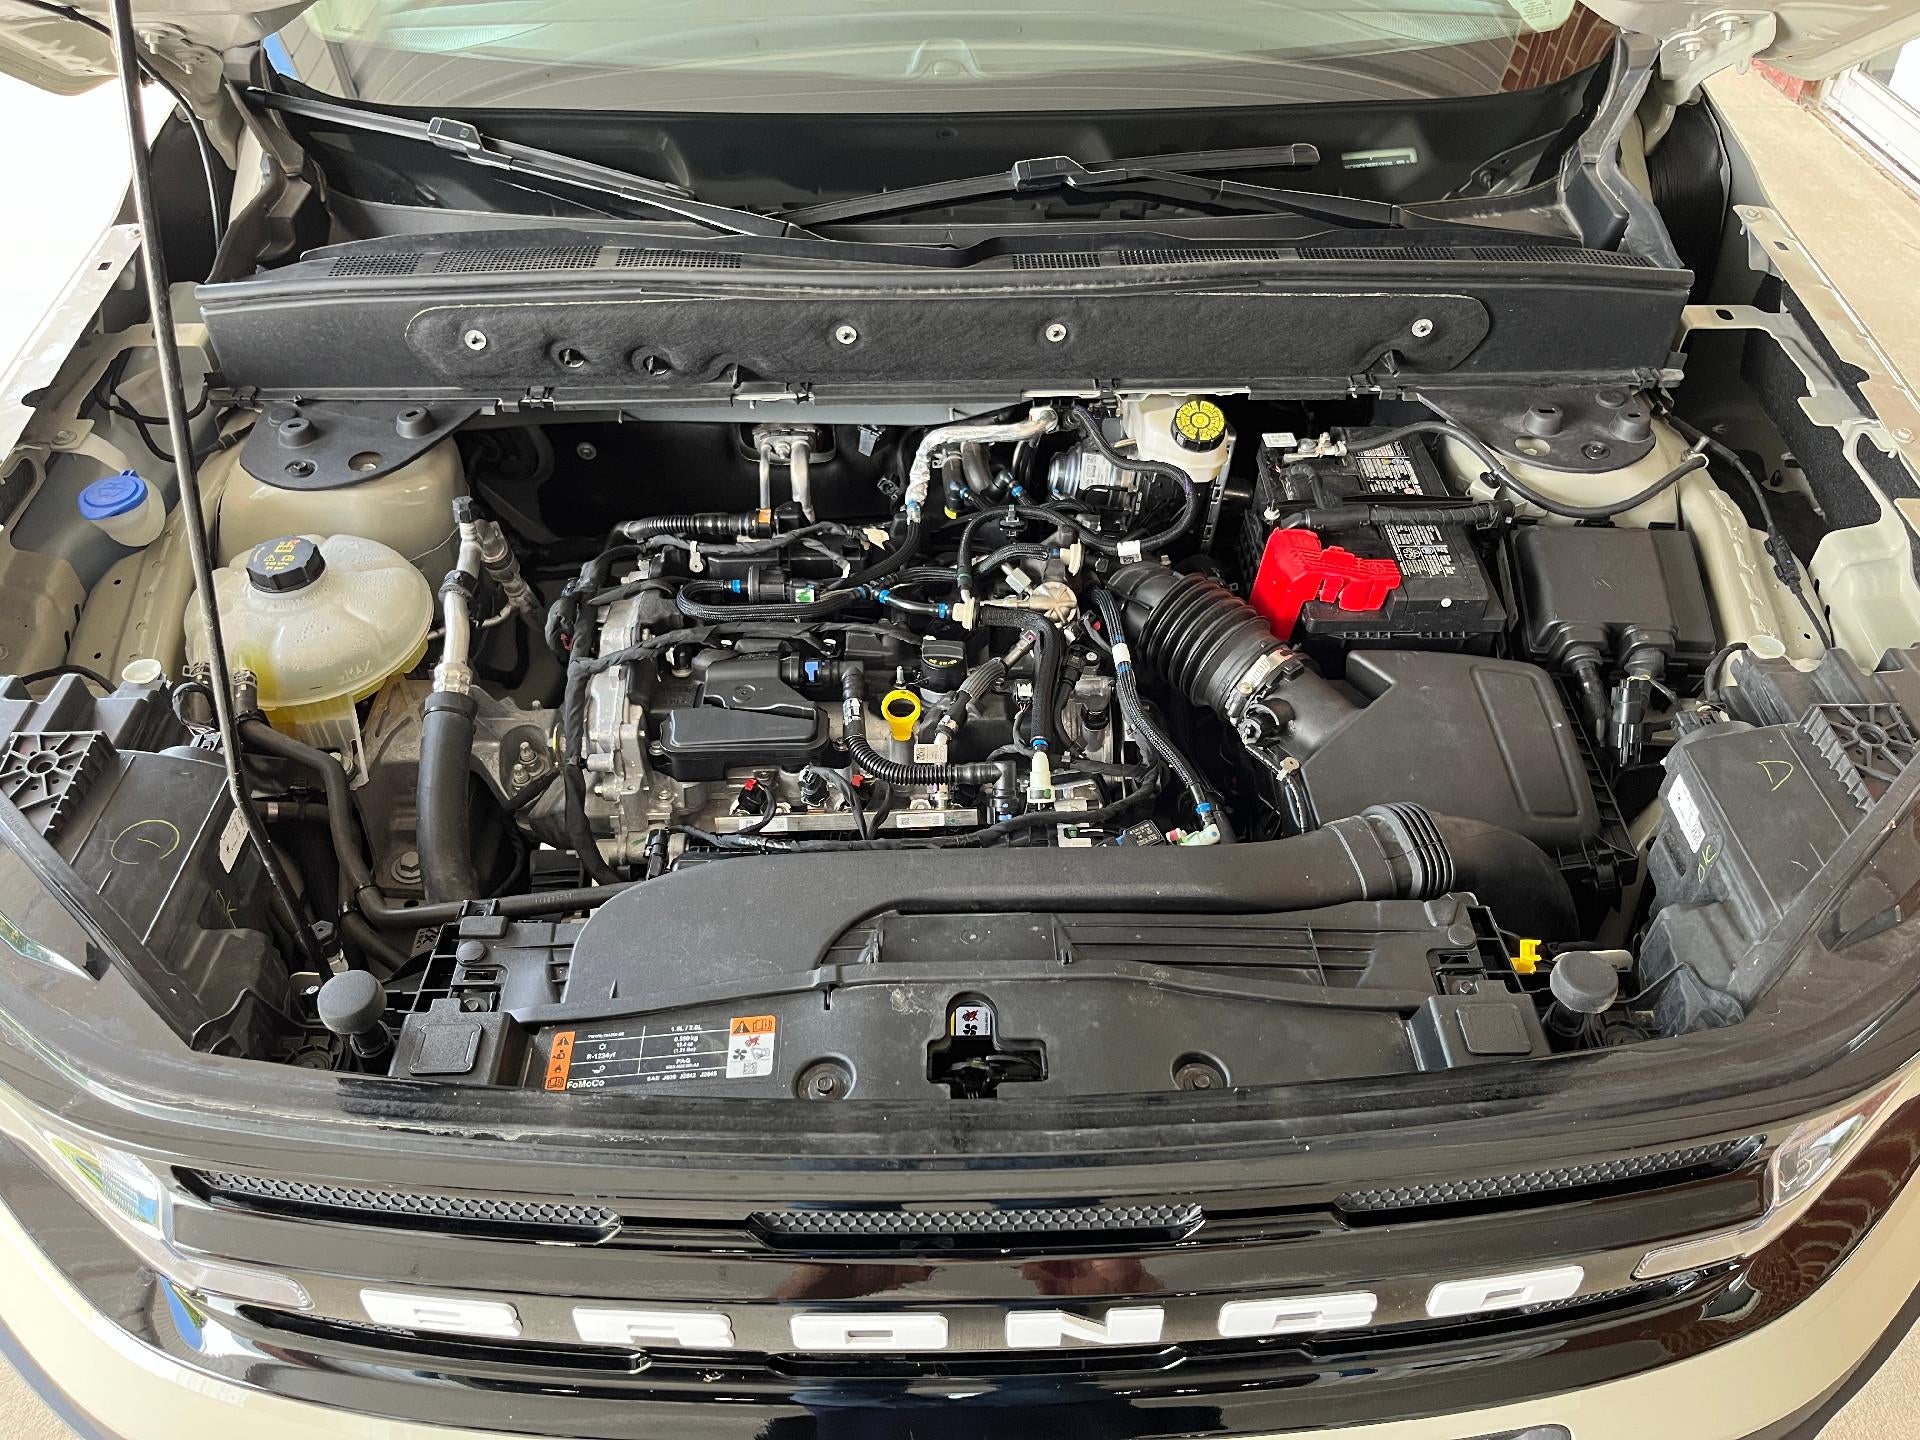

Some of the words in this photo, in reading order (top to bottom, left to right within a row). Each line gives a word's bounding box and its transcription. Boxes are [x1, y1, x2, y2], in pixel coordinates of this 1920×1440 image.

[586, 1051, 617, 1061] R-1234yf
[566, 1078, 606, 1090] FoMoCo
[360, 1265, 1585, 1350] BRONCO
